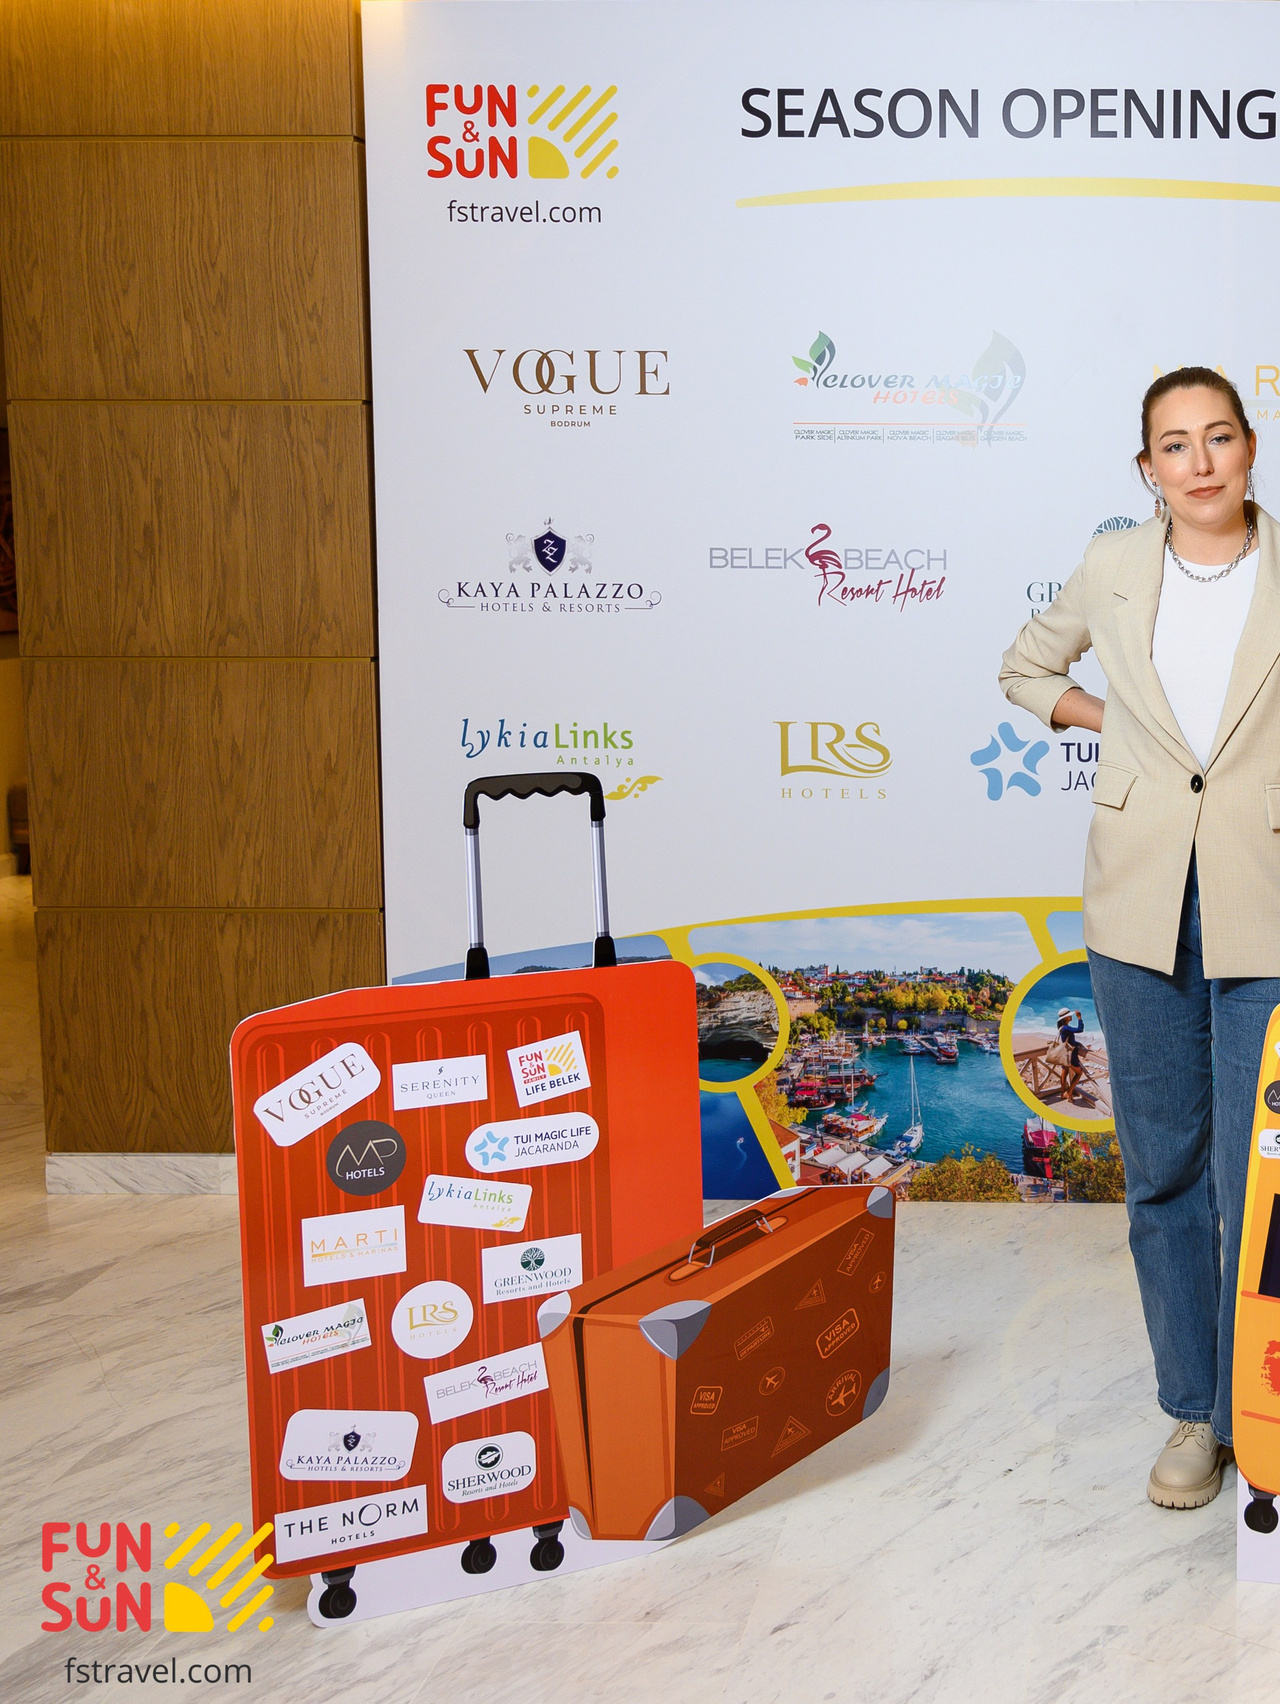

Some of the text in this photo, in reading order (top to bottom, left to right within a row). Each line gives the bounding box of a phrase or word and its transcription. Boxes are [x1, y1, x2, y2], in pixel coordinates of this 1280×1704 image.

[426, 84, 516, 127] FUN
[742, 88, 978, 138] SEASON
[1003, 89, 1276, 139] OPENING
[462, 121, 480, 144] &
[427, 136, 517, 179] SUN
[447, 200, 601, 222] fstravel.com
[463, 349, 669, 395] VOGUE
[823, 374, 915, 388] CLOVER
[524, 405, 616, 415] SUPREME
[709, 547, 947, 571] BELEK BEACH
[457, 582, 643, 599] KAYA PALAZZO
[818, 569, 946, 612] Resort Hotel
[481, 602, 619, 612] HOTELS & RESORTS
[773, 722, 892, 778] LRS
[1060, 743, 1099, 762] TUI
[557, 755, 634, 768] Antalya
[781, 788, 886, 800] HOTELS
[519, 1051, 543, 1067] FUN
[521, 1063, 546, 1078] SUN
[263, 1053, 365, 1122] VOGUE
[401, 1075, 479, 1092] SERENITY
[525, 1073, 581, 1096] LIFE BELEK
[427, 1091, 456, 1099] QUEEN
[305, 1089, 347, 1119] SUPREME
[514, 1126, 591, 1144] TUI MAGIC LIFE
[515, 1140, 579, 1157] JACARANDA
[346, 1167, 385, 1180] HOTELS
[473, 1203, 512, 1212] Antalya
[311, 1229, 398, 1253] MARTI
[312, 1255, 346, 1263] HOTELS
[357, 1247, 398, 1256] MARINAS
[494, 1267, 572, 1287] GREENWOOD
[496, 1278, 571, 1295] Resorts and Hotels
[406, 1301, 459, 1330] LRS
[410, 1327, 458, 1339] HOTELS
[824, 1322, 855, 1352] APPROVED
[825, 1319, 849, 1341] VISA
[436, 1361, 537, 1399] BELEK BEACH
[700, 1392, 715, 1401] VISA
[724, 1427, 756, 1444] APPROVED
[732, 1424, 747, 1434] VISA
[297, 1456, 397, 1465] KAYA PALAZZO
[448, 1465, 531, 1491] SHERWOOD
[462, 1480, 518, 1496] Resorts and Hotels
[284, 1499, 419, 1538] THE NORM
[332, 1531, 375, 1544] HOTELS
